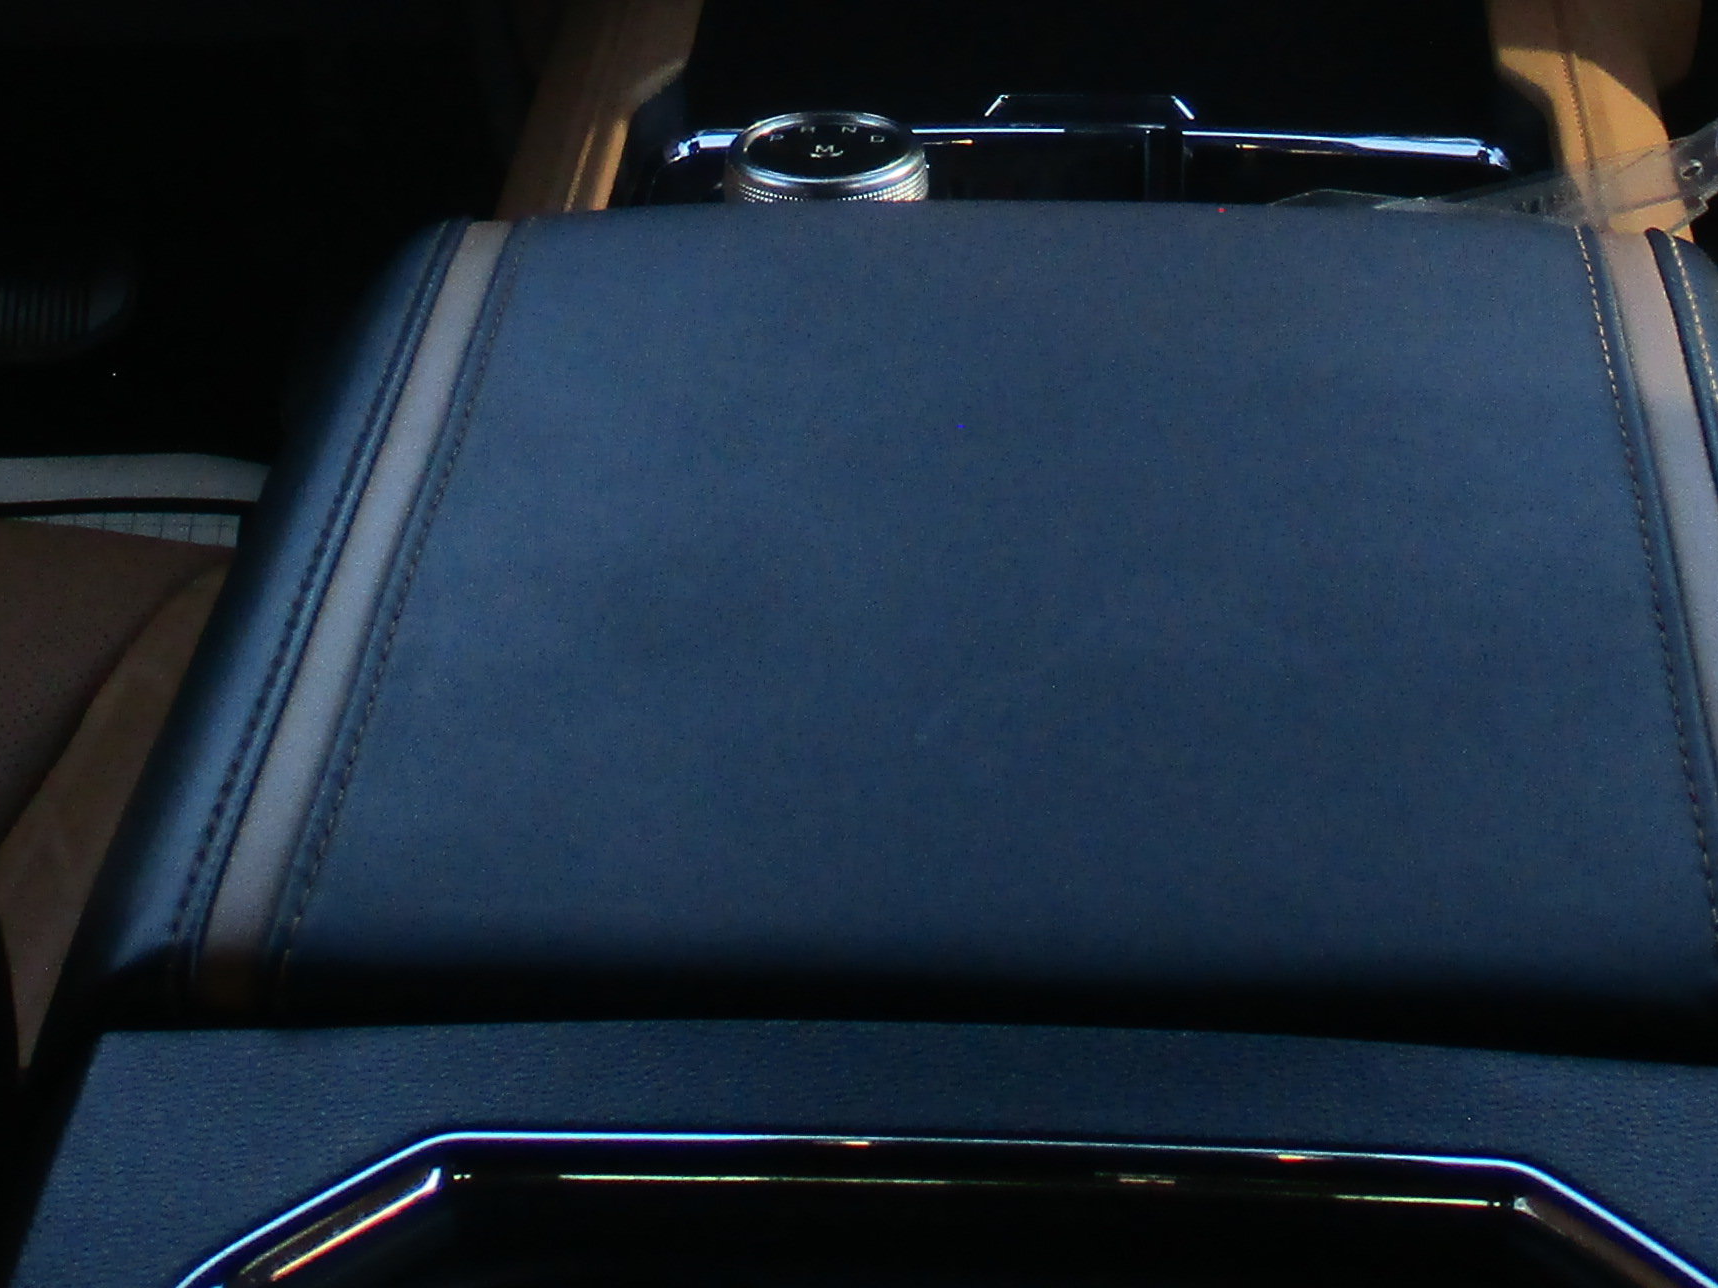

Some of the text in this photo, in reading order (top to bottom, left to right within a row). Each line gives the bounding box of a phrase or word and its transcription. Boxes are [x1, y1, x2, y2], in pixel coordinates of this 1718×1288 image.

[841, 125, 857, 134] N
[869, 135, 885, 143] D
[815, 144, 835, 153] M
